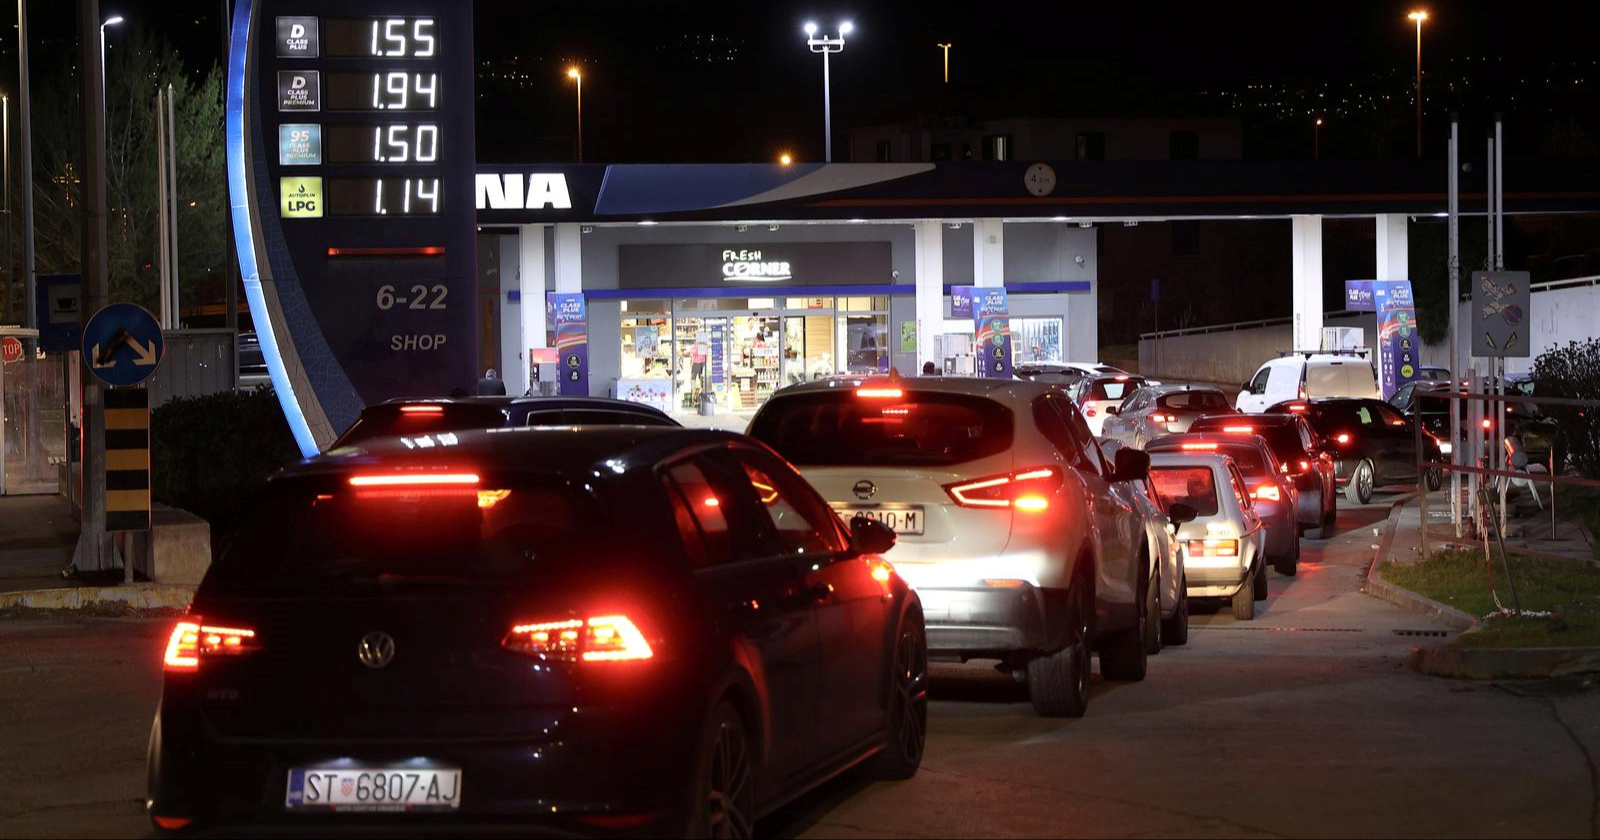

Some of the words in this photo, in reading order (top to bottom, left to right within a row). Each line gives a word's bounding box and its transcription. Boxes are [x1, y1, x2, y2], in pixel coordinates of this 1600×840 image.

[290, 24, 305, 38] D
[371, 19, 434, 56] 1.55
[291, 76, 306, 89] D
[373, 72, 436, 109] 1.94
[290, 130, 309, 142] 95
[374, 125, 438, 162] 1.50
[375, 179, 439, 215] 1.14
[475, 173, 572, 209] NA
[288, 200, 316, 212] LPG
[722, 249, 762, 261] FRESH
[722, 261, 791, 277] CORNER
[376, 284, 448, 310] 6-22
[3, 344, 20, 355] TOP
[390, 334, 447, 351] SHOP
[306, 773, 338, 801] ST
